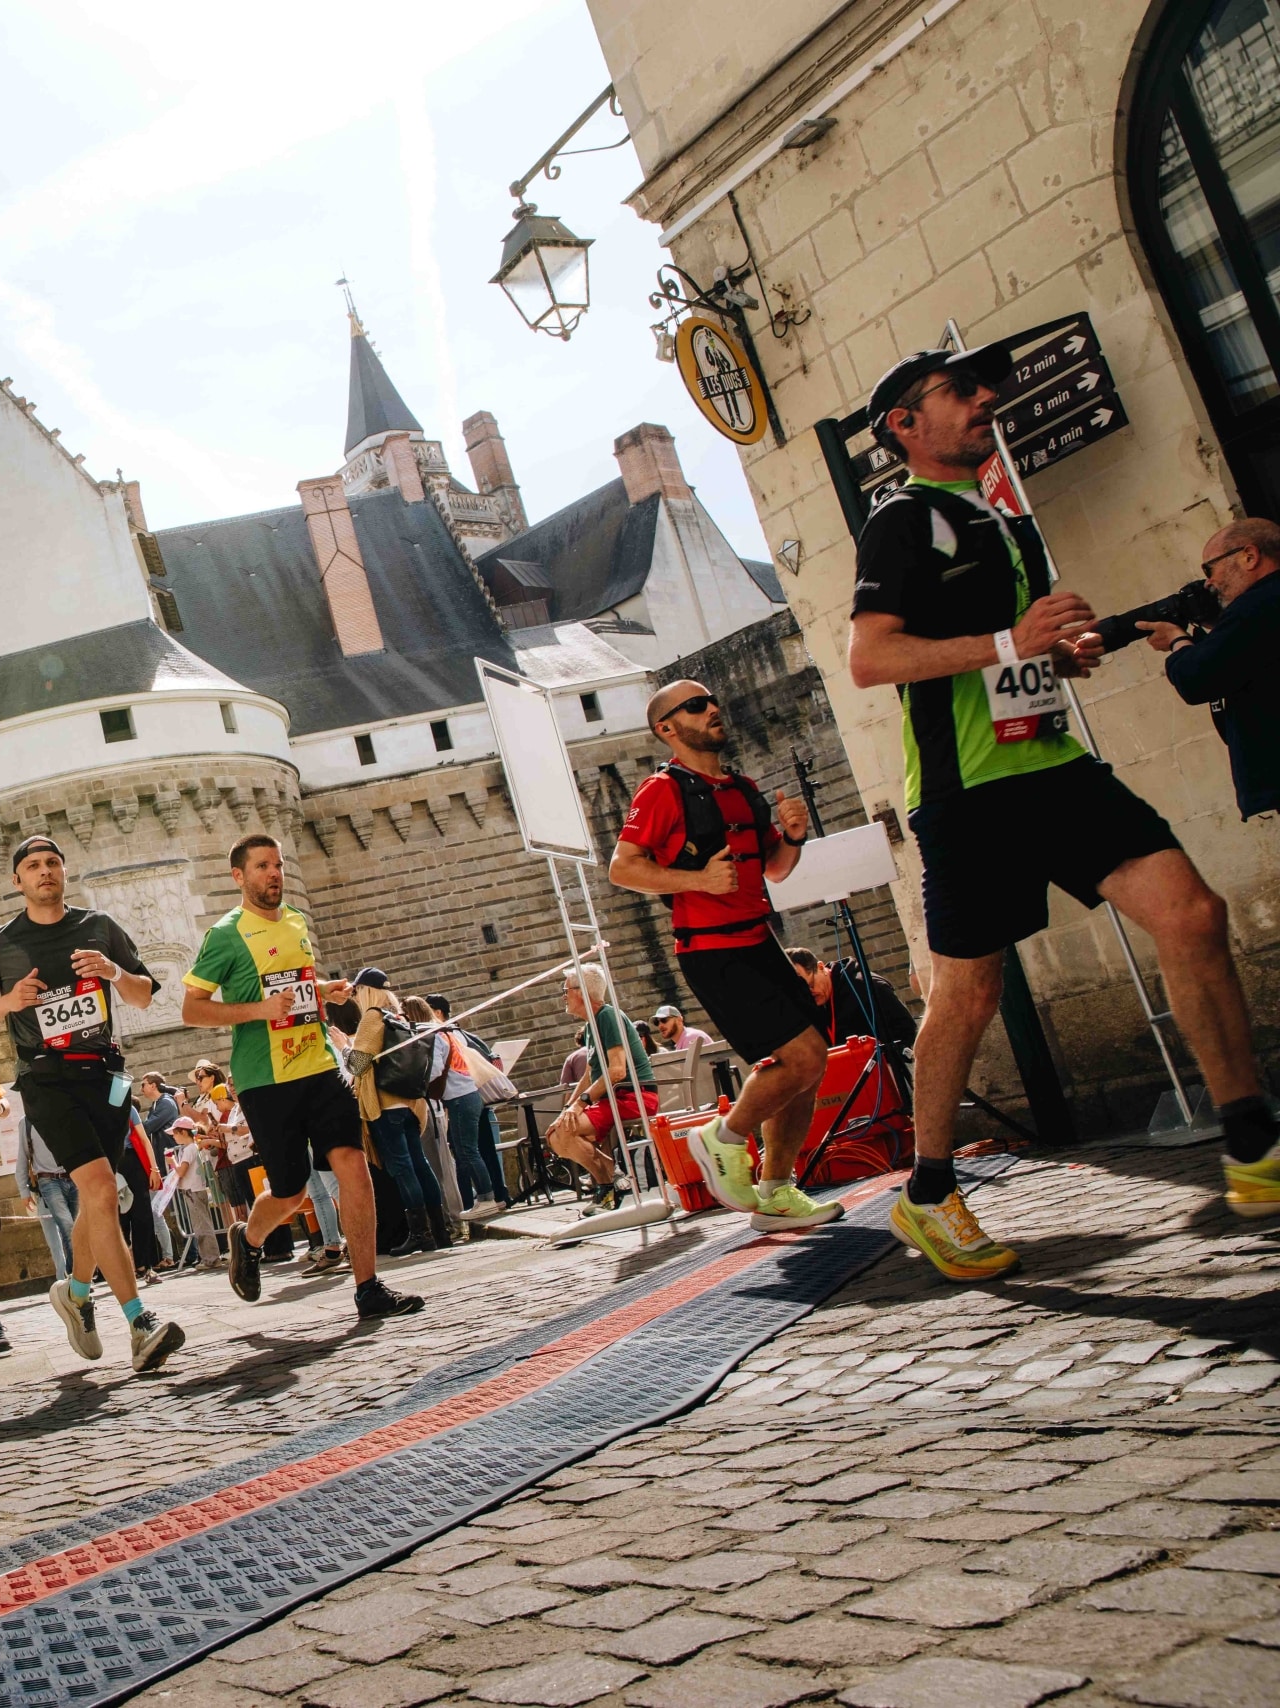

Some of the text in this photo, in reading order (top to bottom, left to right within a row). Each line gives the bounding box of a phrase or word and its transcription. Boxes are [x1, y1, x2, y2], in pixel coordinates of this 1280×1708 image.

[1015, 352, 1057, 384] 12 min
[704, 374, 723, 395] LES
[1033, 388, 1070, 417] 8 min
[1047, 425, 1083, 451] 4 min
[995, 660, 1061, 698] 405
[264, 970, 298, 982] ABALONE
[36, 985, 72, 1000] ABALONE
[41, 996, 96, 1027] 3643
